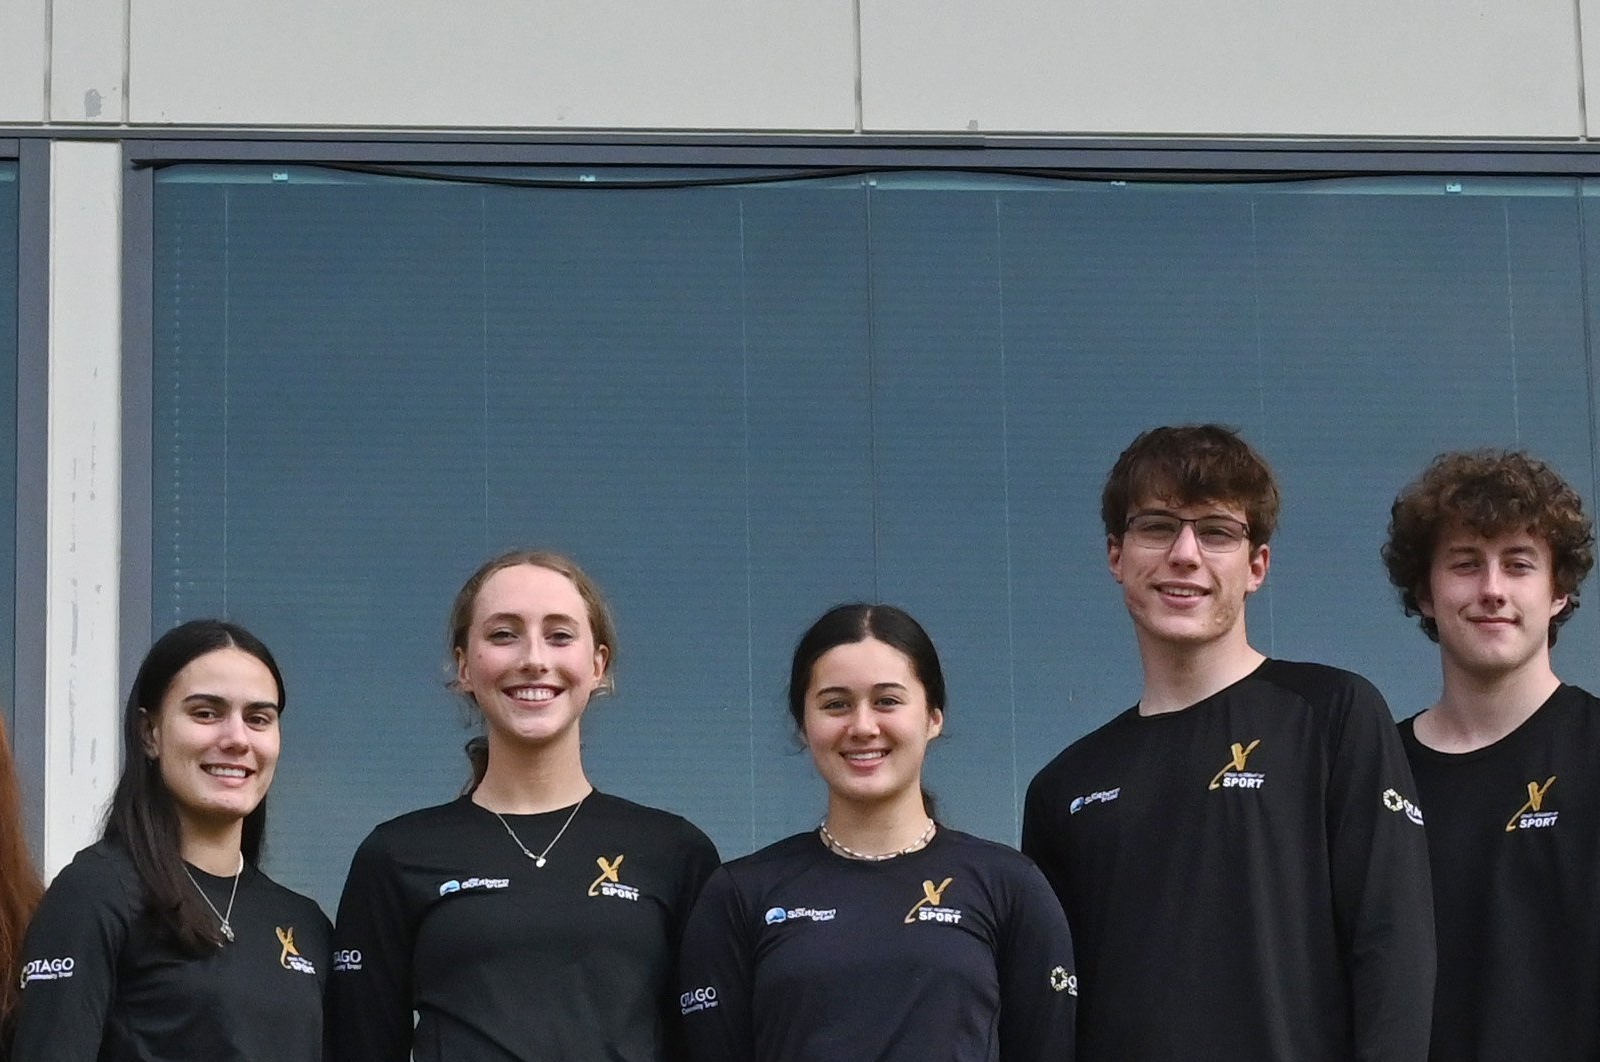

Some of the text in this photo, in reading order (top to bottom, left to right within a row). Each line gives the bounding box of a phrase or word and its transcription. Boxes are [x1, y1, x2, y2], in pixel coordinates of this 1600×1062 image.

[1222, 777, 1265, 789] SPORT
[1519, 816, 1559, 829] SPORT
[601, 886, 640, 901] SPORT
[918, 911, 962, 924] SPORT
[27, 957, 74, 975] OTAGO
